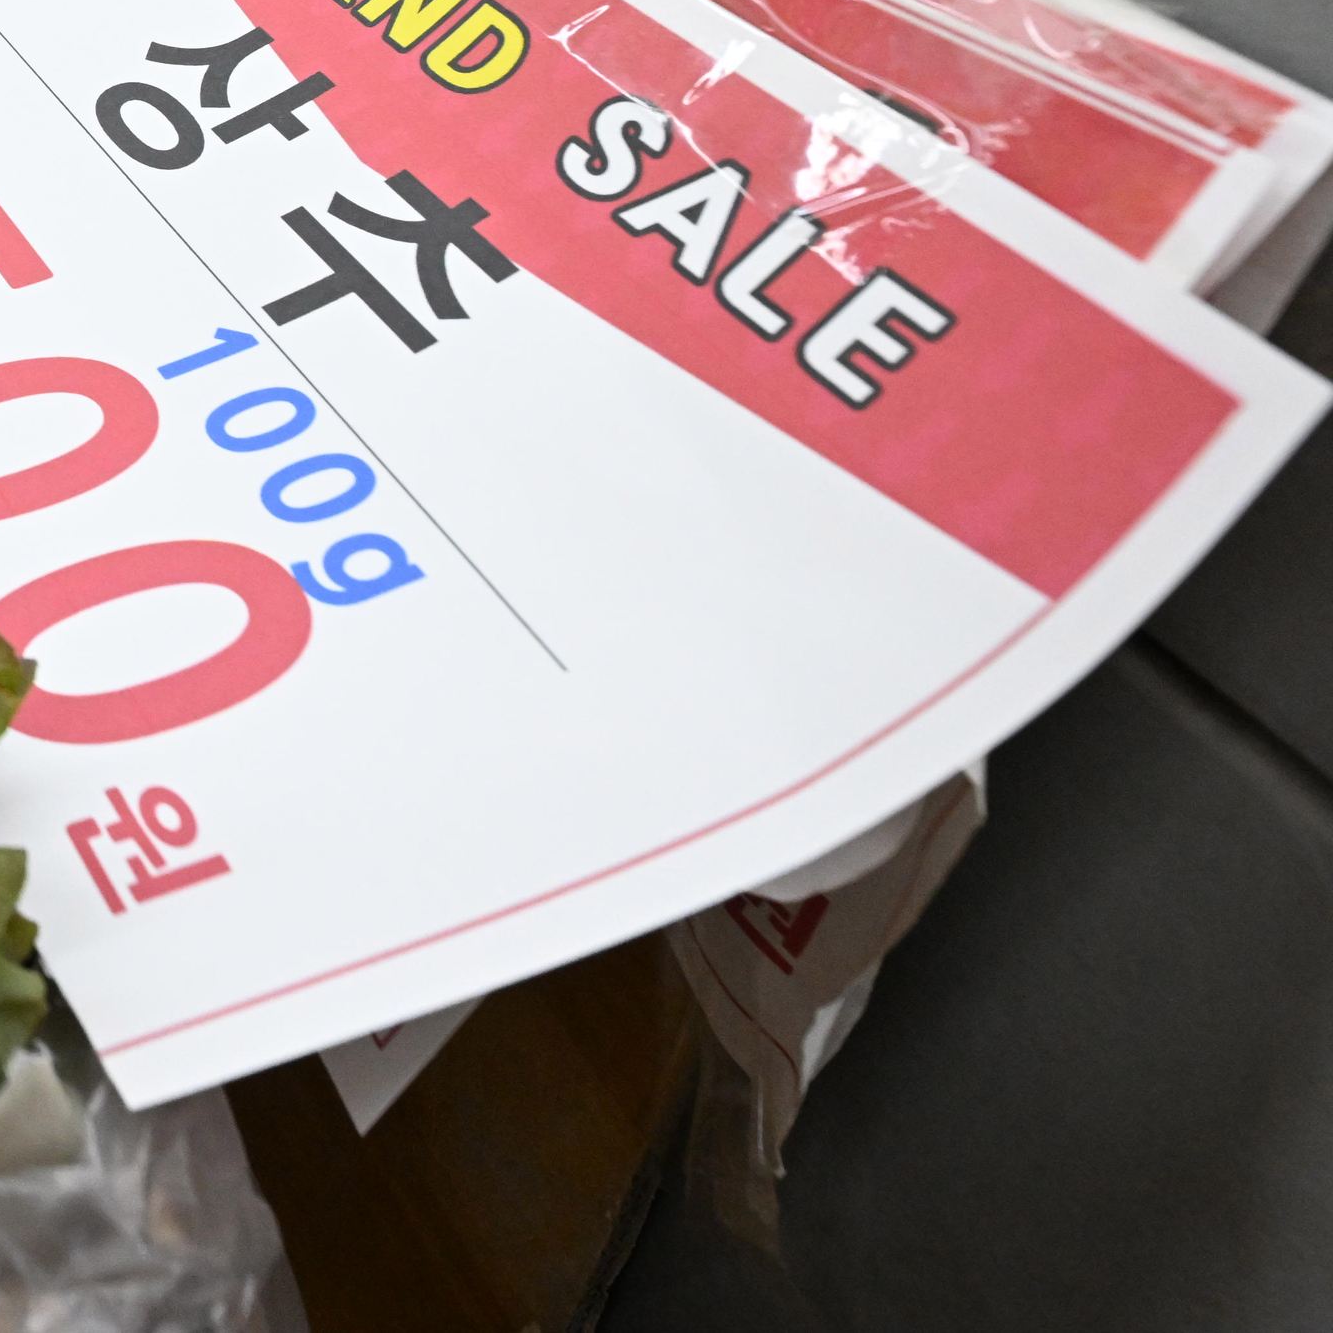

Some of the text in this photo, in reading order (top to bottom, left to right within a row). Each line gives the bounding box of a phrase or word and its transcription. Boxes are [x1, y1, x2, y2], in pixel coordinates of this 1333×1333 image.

[94, 25, 521, 353] 상추
[555, 95, 957, 411] SALE
[155, 326, 426, 607] 100g
